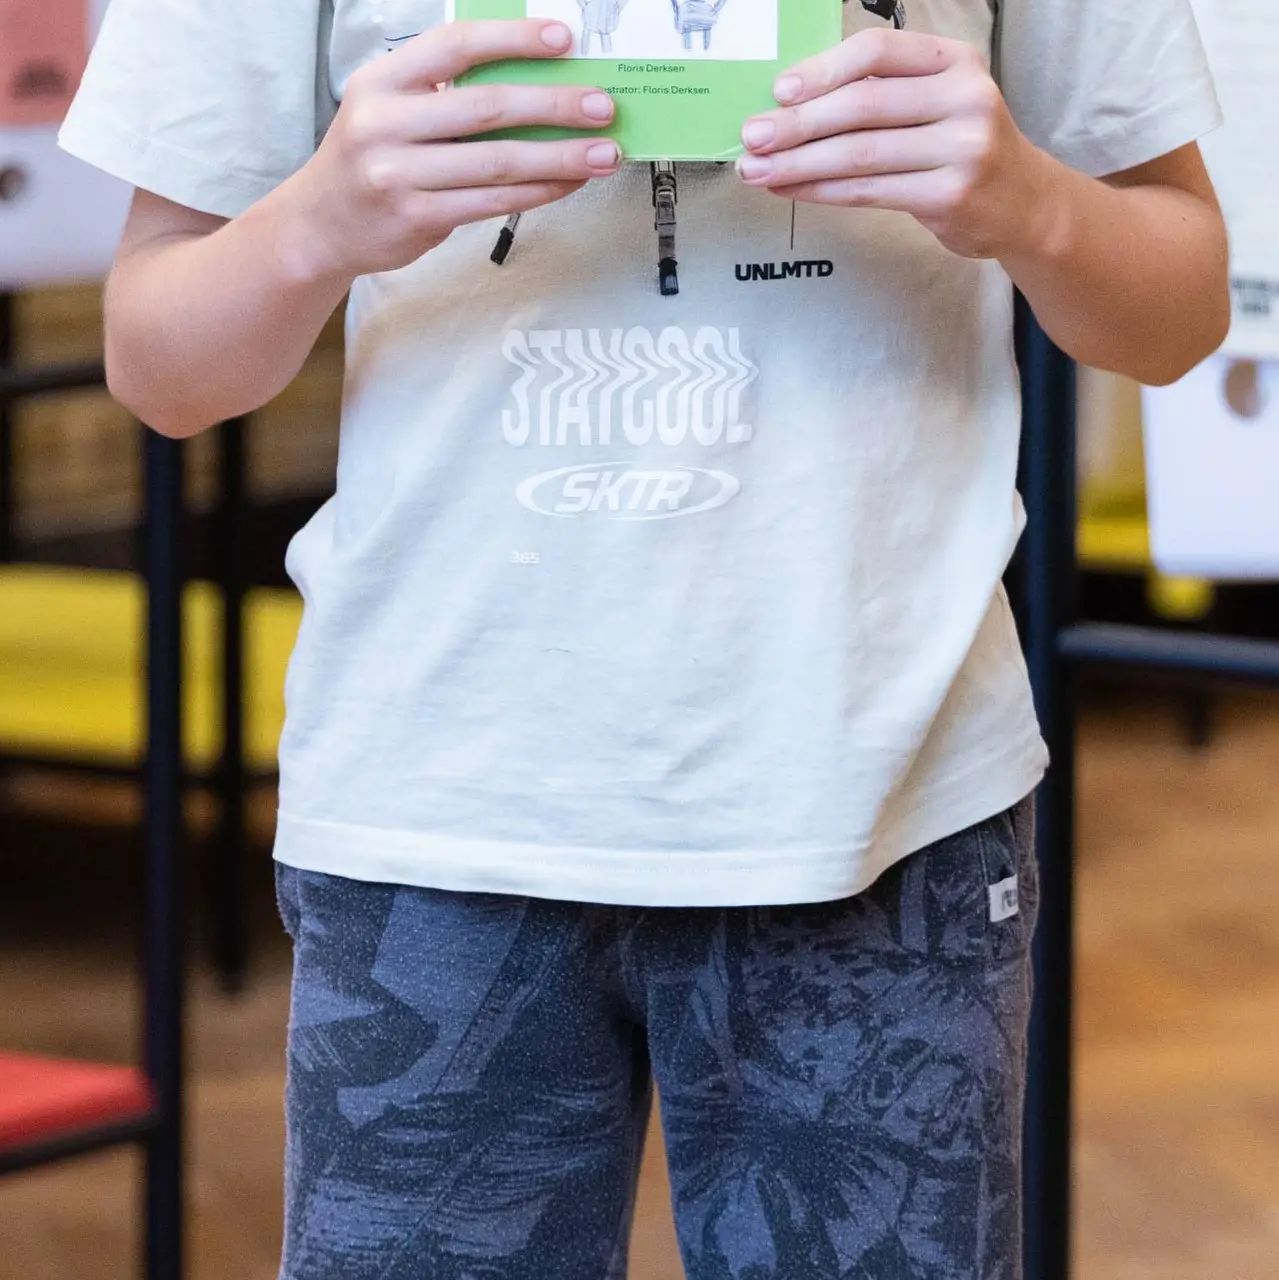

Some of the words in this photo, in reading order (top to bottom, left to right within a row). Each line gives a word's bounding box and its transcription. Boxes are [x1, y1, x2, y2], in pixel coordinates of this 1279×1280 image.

[617, 63, 644, 73] Floris
[646, 63, 685, 73] Derksen
[642, 85, 669, 95] Floris
[670, 85, 710, 95] Derksen
[735, 260, 833, 282] UNLMTD
[554, 471, 695, 512] SKTR
[510, 551, 540, 564] 365
